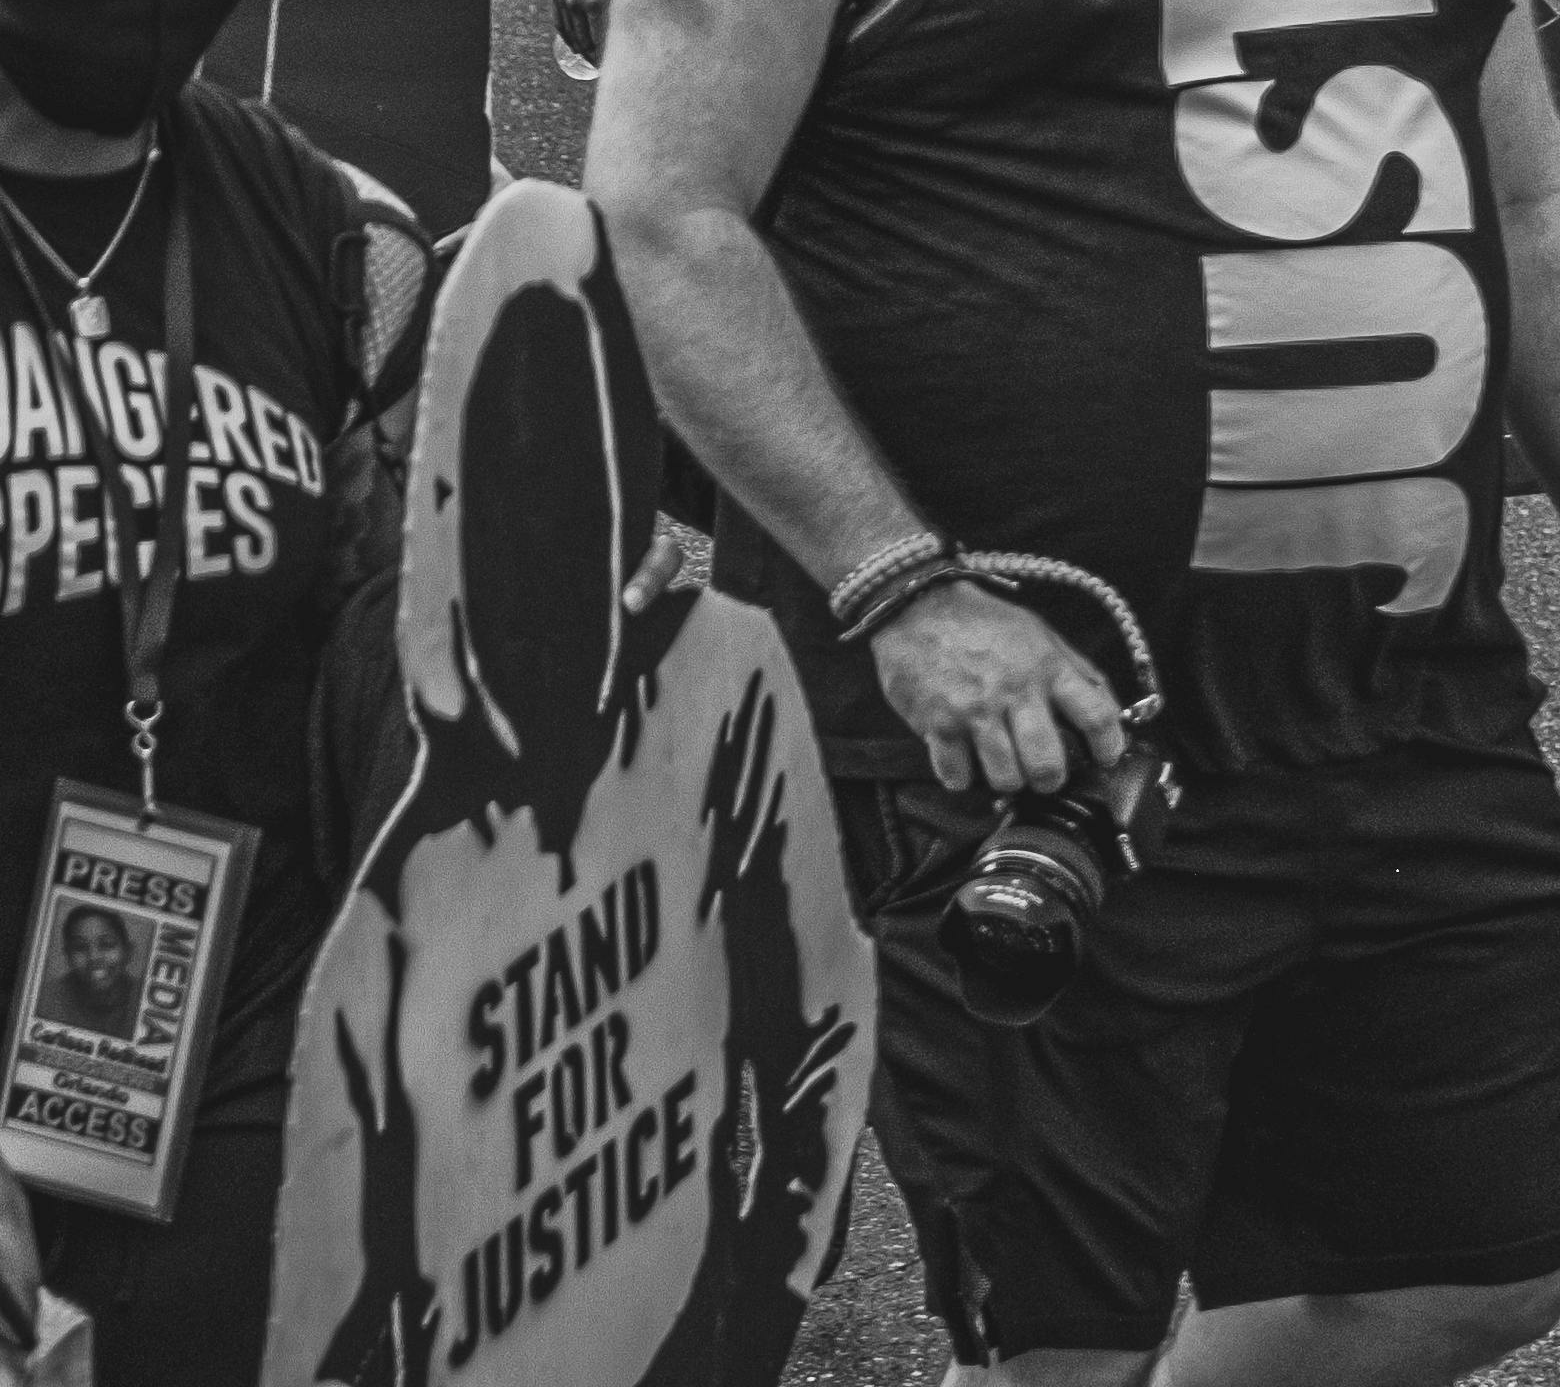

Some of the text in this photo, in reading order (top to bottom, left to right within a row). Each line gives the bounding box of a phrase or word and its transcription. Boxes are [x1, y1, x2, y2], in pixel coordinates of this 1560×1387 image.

[62, 854, 197, 917] PRESS
[135, 924, 197, 1047] MEDIA
[468, 857, 660, 1101] STAND
[17, 1090, 149, 1150] ACCESS
[511, 1010, 632, 1195] FOR
[447, 1068, 697, 1370] JUSTICE
